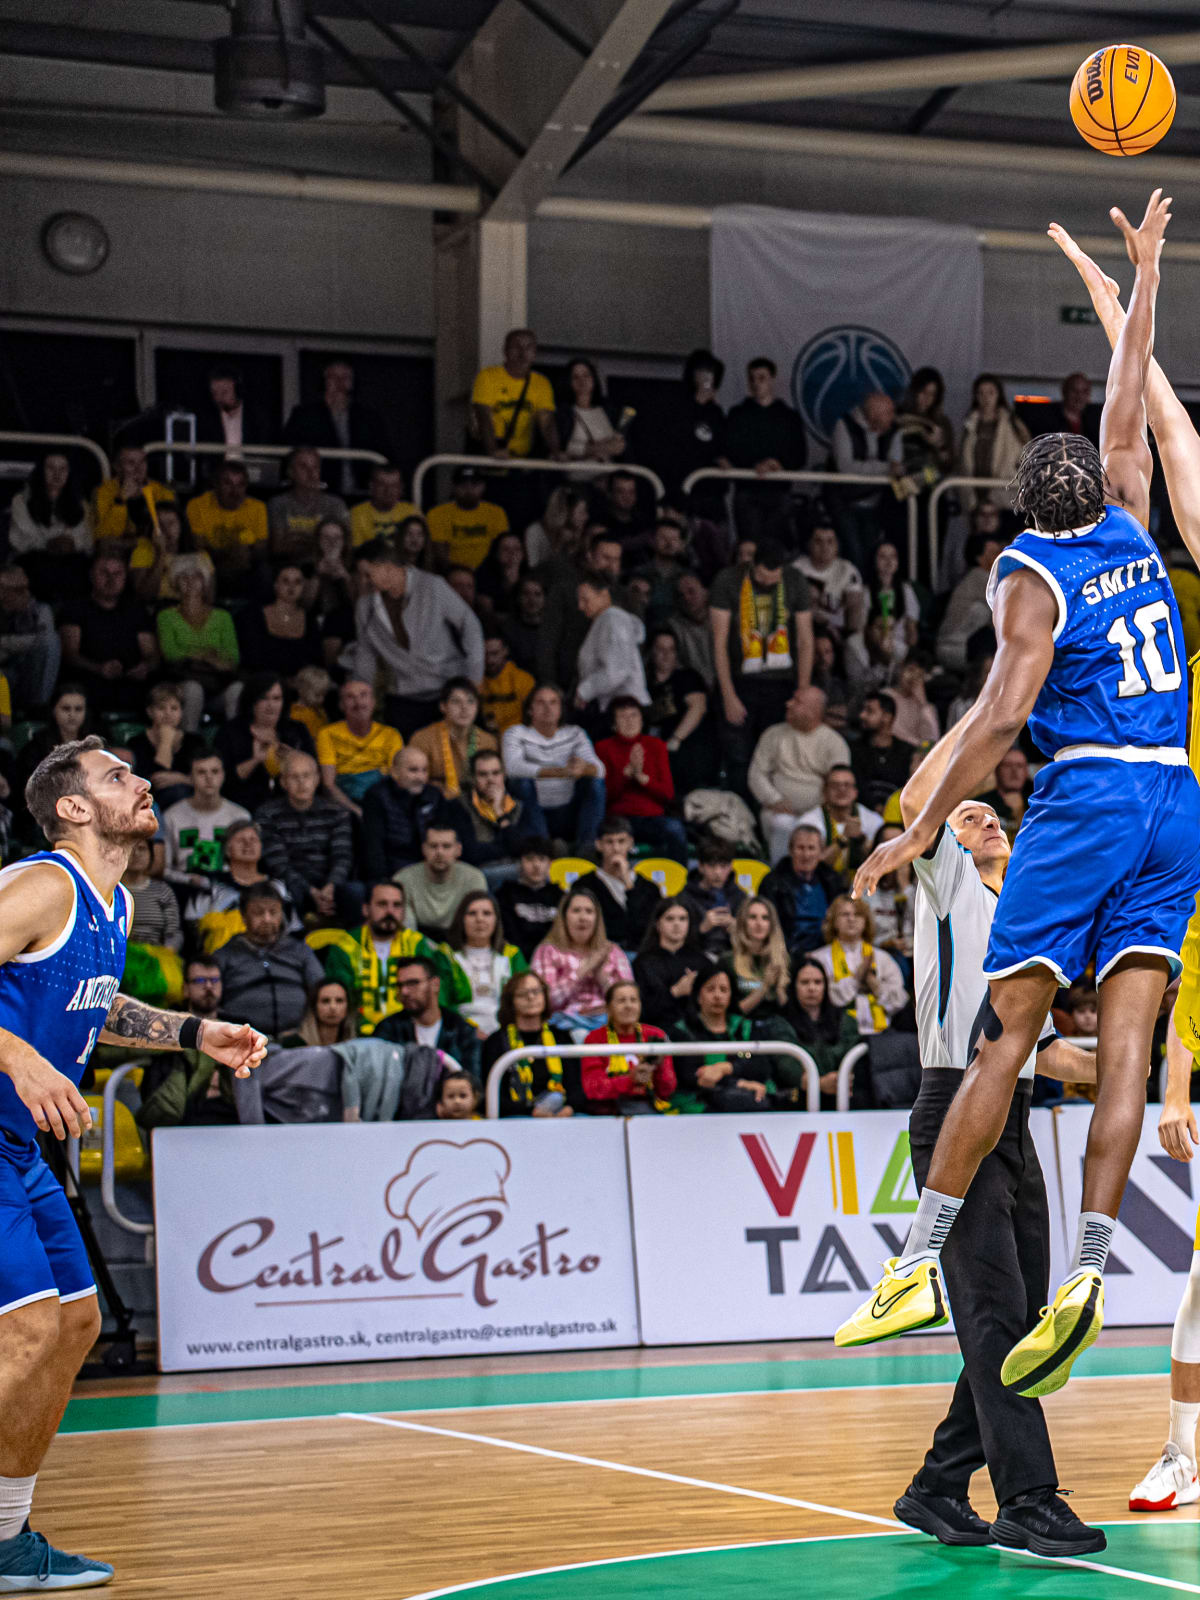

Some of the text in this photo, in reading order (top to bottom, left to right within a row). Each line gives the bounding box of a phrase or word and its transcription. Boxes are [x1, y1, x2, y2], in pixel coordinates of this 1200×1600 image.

[1106, 599, 1182, 697] 10
[197, 1209, 601, 1307] Central Gastro
[186, 1318, 617, 1356] www.centralgastro.sk, centralgastro@centralgastro.sk
